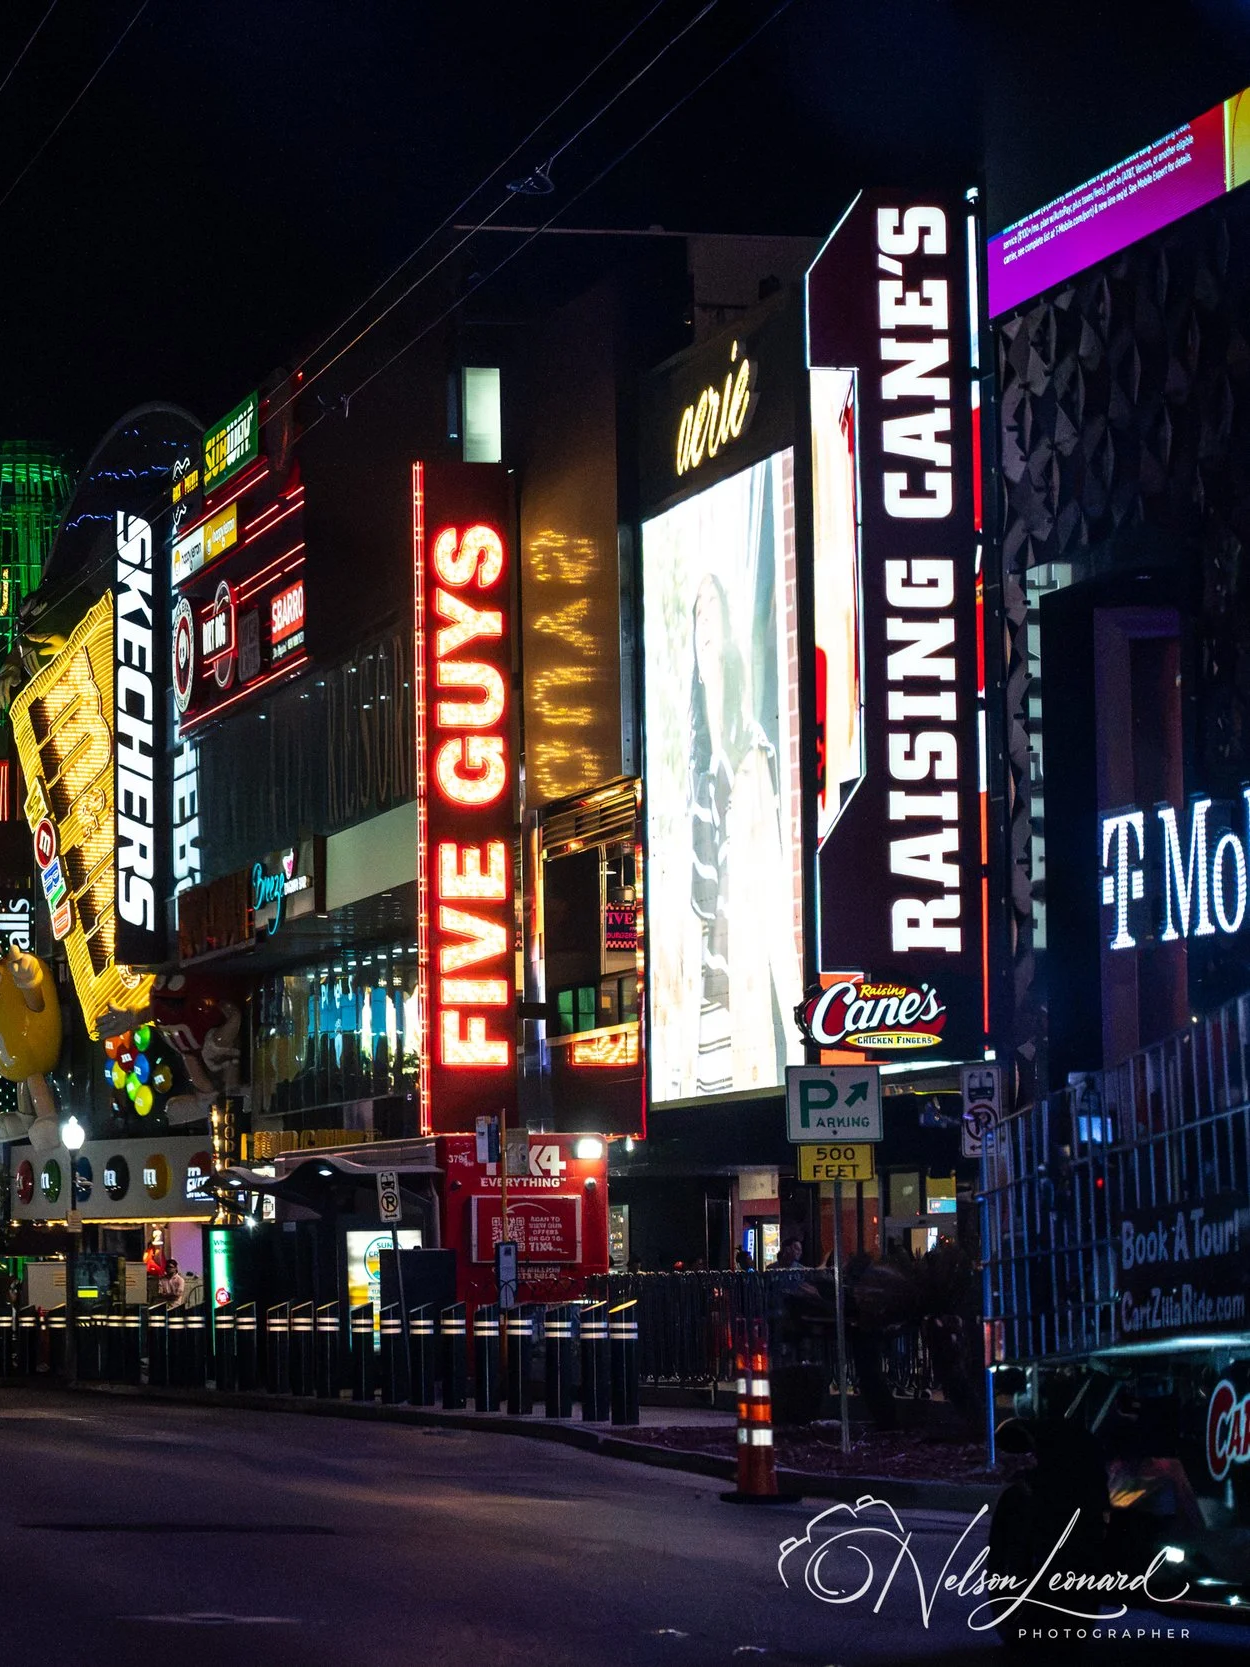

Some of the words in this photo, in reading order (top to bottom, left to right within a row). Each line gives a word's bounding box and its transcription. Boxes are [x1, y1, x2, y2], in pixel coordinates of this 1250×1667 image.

[878, 206, 952, 518] CANE'S
[204, 400, 254, 486] SUBWAY
[676, 340, 750, 476] aerie
[272, 585, 304, 633] SBARRO
[435, 524, 505, 806] GUYS
[116, 510, 155, 932] SKECHERS
[885, 560, 962, 953] RAISING
[607, 912, 634, 925] IVE
[440, 842, 509, 1067] FIVE
[811, 975, 946, 1045] Cane's
[859, 984, 907, 999] Raising
[857, 1036, 893, 1044] CHICKEN
[897, 1036, 933, 1044] FINGERS
[813, 1164, 860, 1178] FEET
[816, 1147, 856, 1161] 500
[1121, 1220, 1168, 1271] Book
[1173, 1212, 1190, 1263] A
